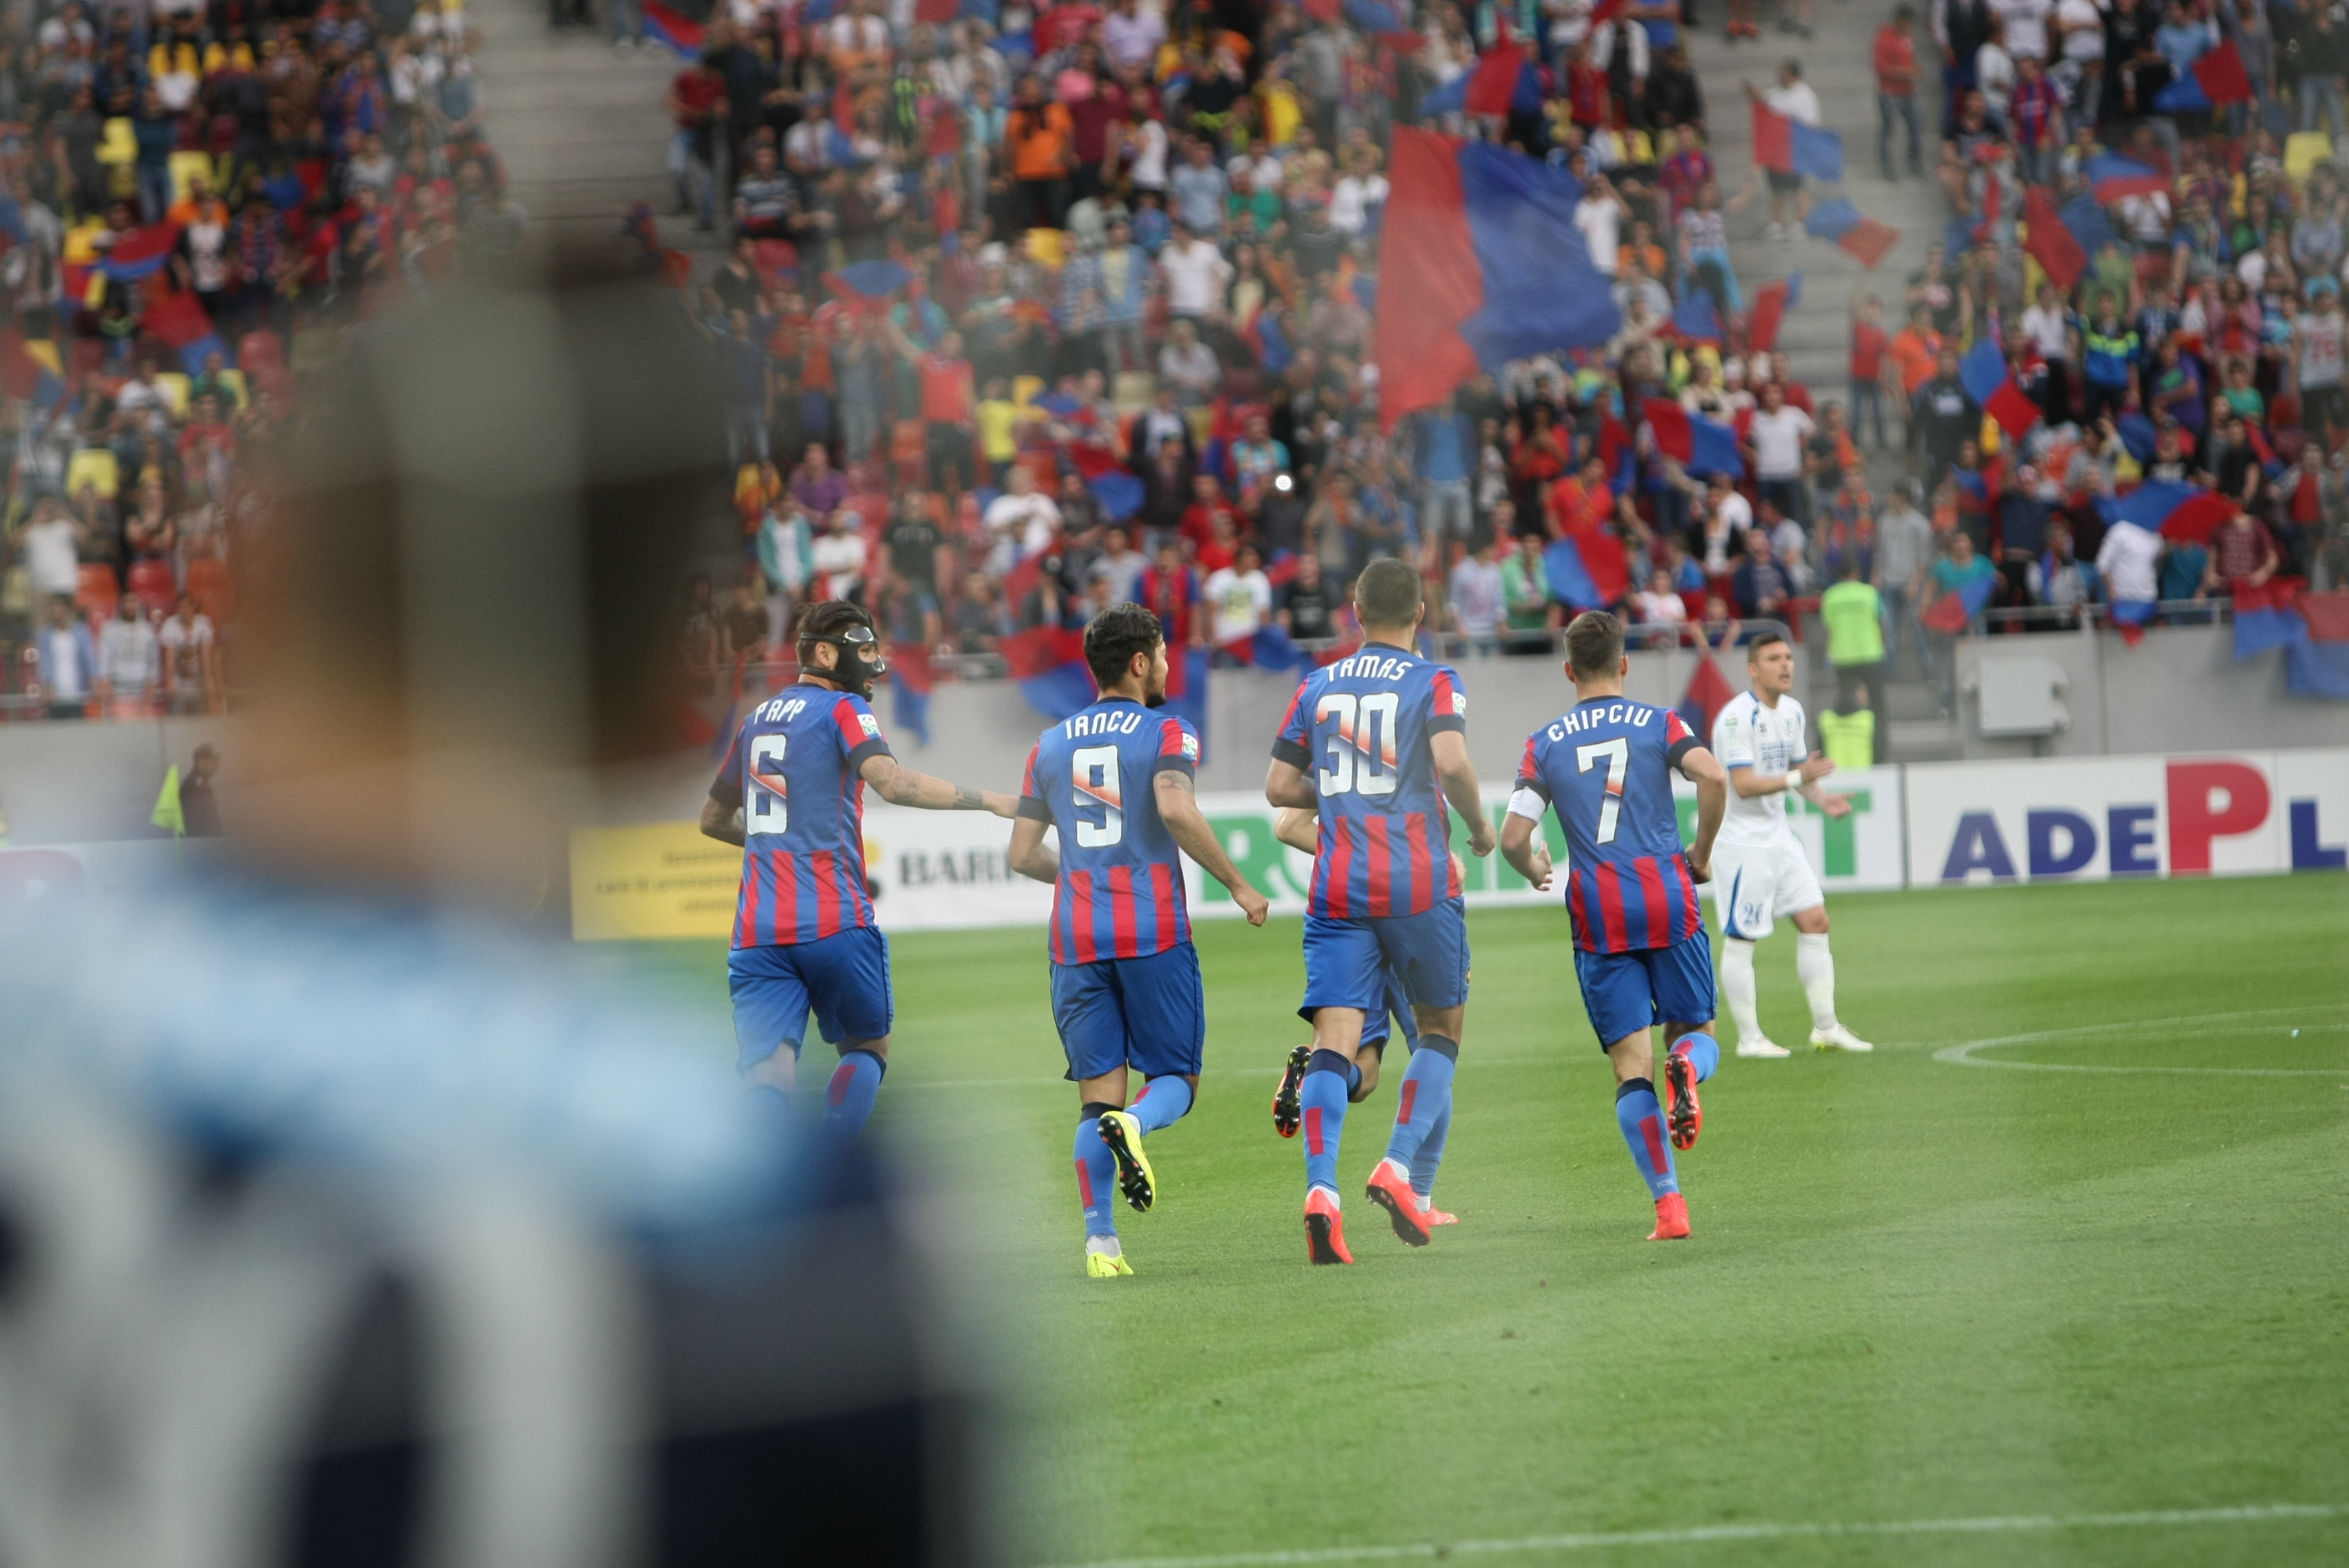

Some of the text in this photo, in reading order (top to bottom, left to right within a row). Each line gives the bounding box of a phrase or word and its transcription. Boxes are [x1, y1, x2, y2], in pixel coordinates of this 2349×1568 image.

[754, 699, 807, 725] PAPP
[1326, 656, 1414, 683] TAMAS
[1065, 711, 1143, 741] IANCU
[1316, 692, 1399, 797] 30
[1547, 705, 1653, 742] CHIPCIU
[747, 734, 787, 835] 6
[1073, 745, 1123, 847] 9
[1577, 737, 1628, 844] 7
[1940, 758, 2346, 881] ADEPL
